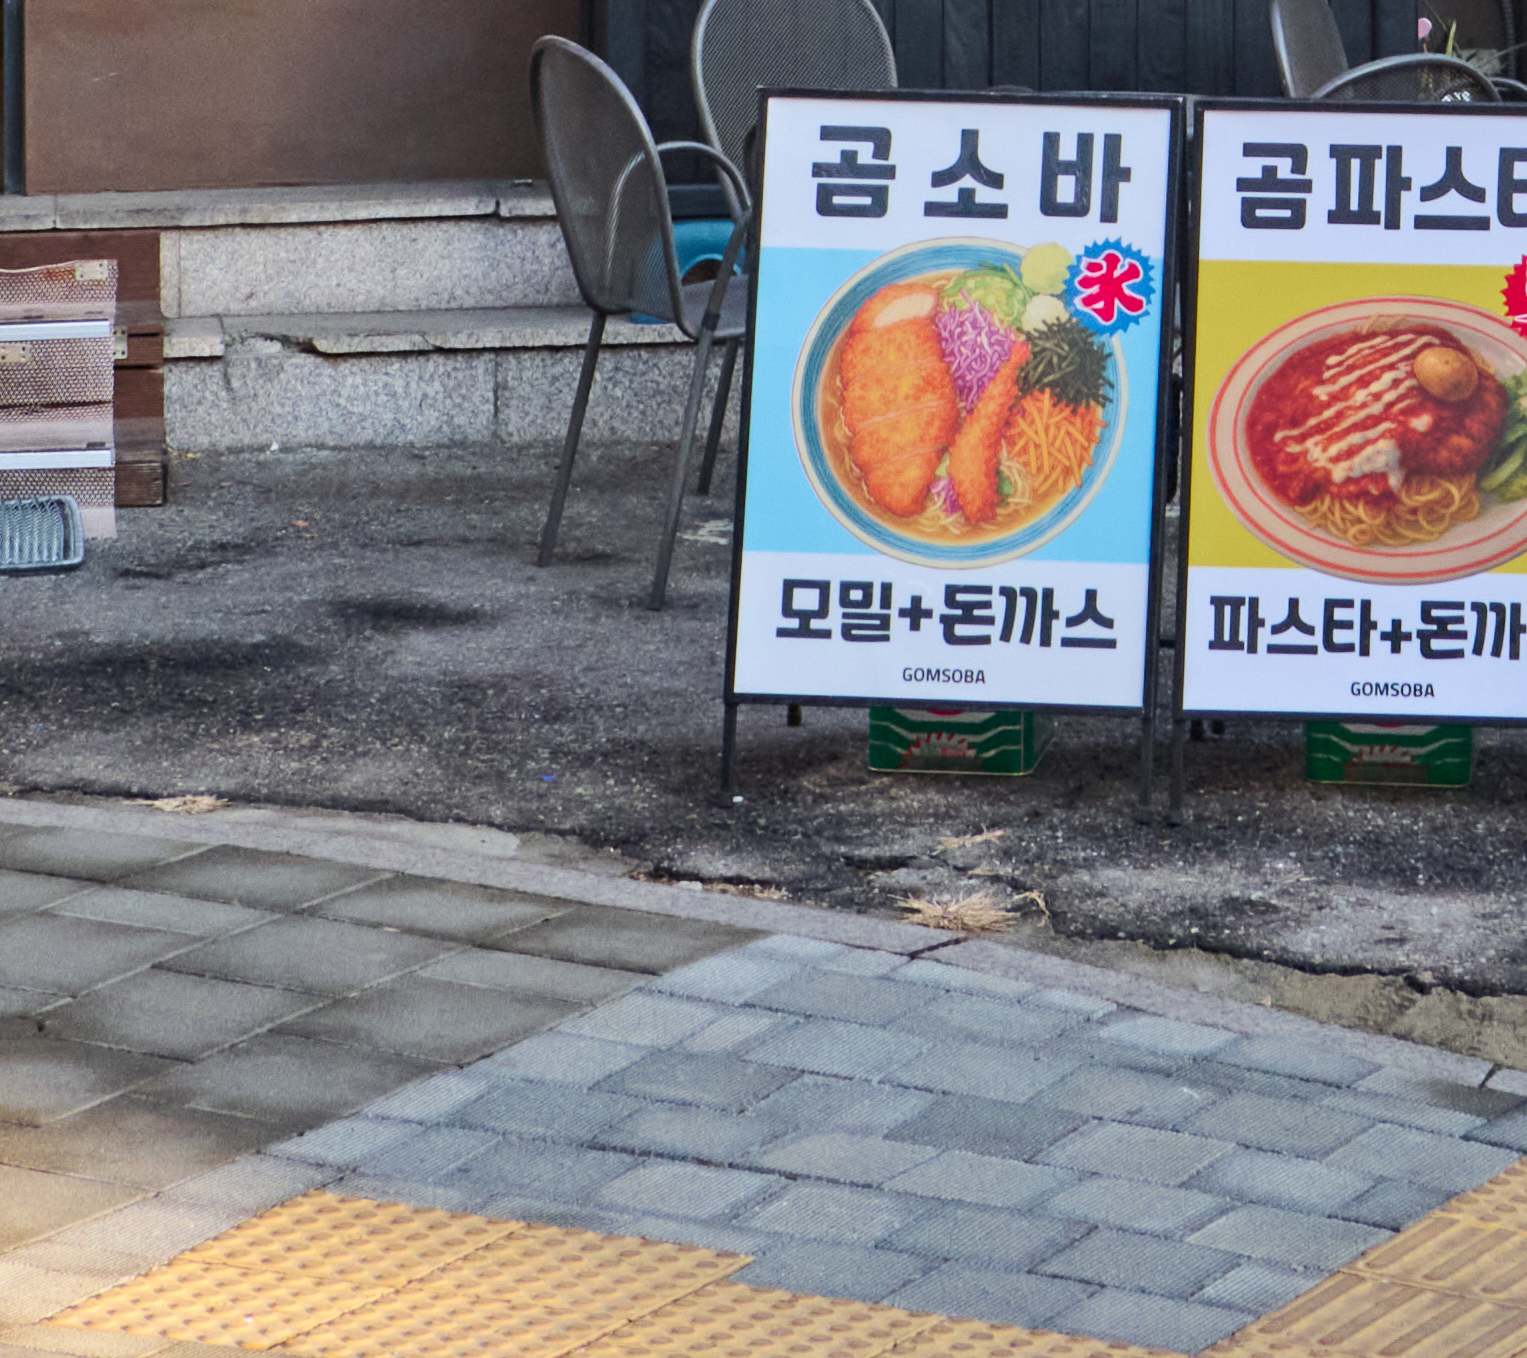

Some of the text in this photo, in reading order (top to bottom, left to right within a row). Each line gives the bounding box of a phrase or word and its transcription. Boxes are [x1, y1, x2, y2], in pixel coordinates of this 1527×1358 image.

[811, 124, 1132, 225] 곰소바
[775, 576, 1117, 654] 모밀+돈까스
[901, 667, 987, 686] GOMSOBA
[1349, 681, 1436, 701] GOMSOBA
